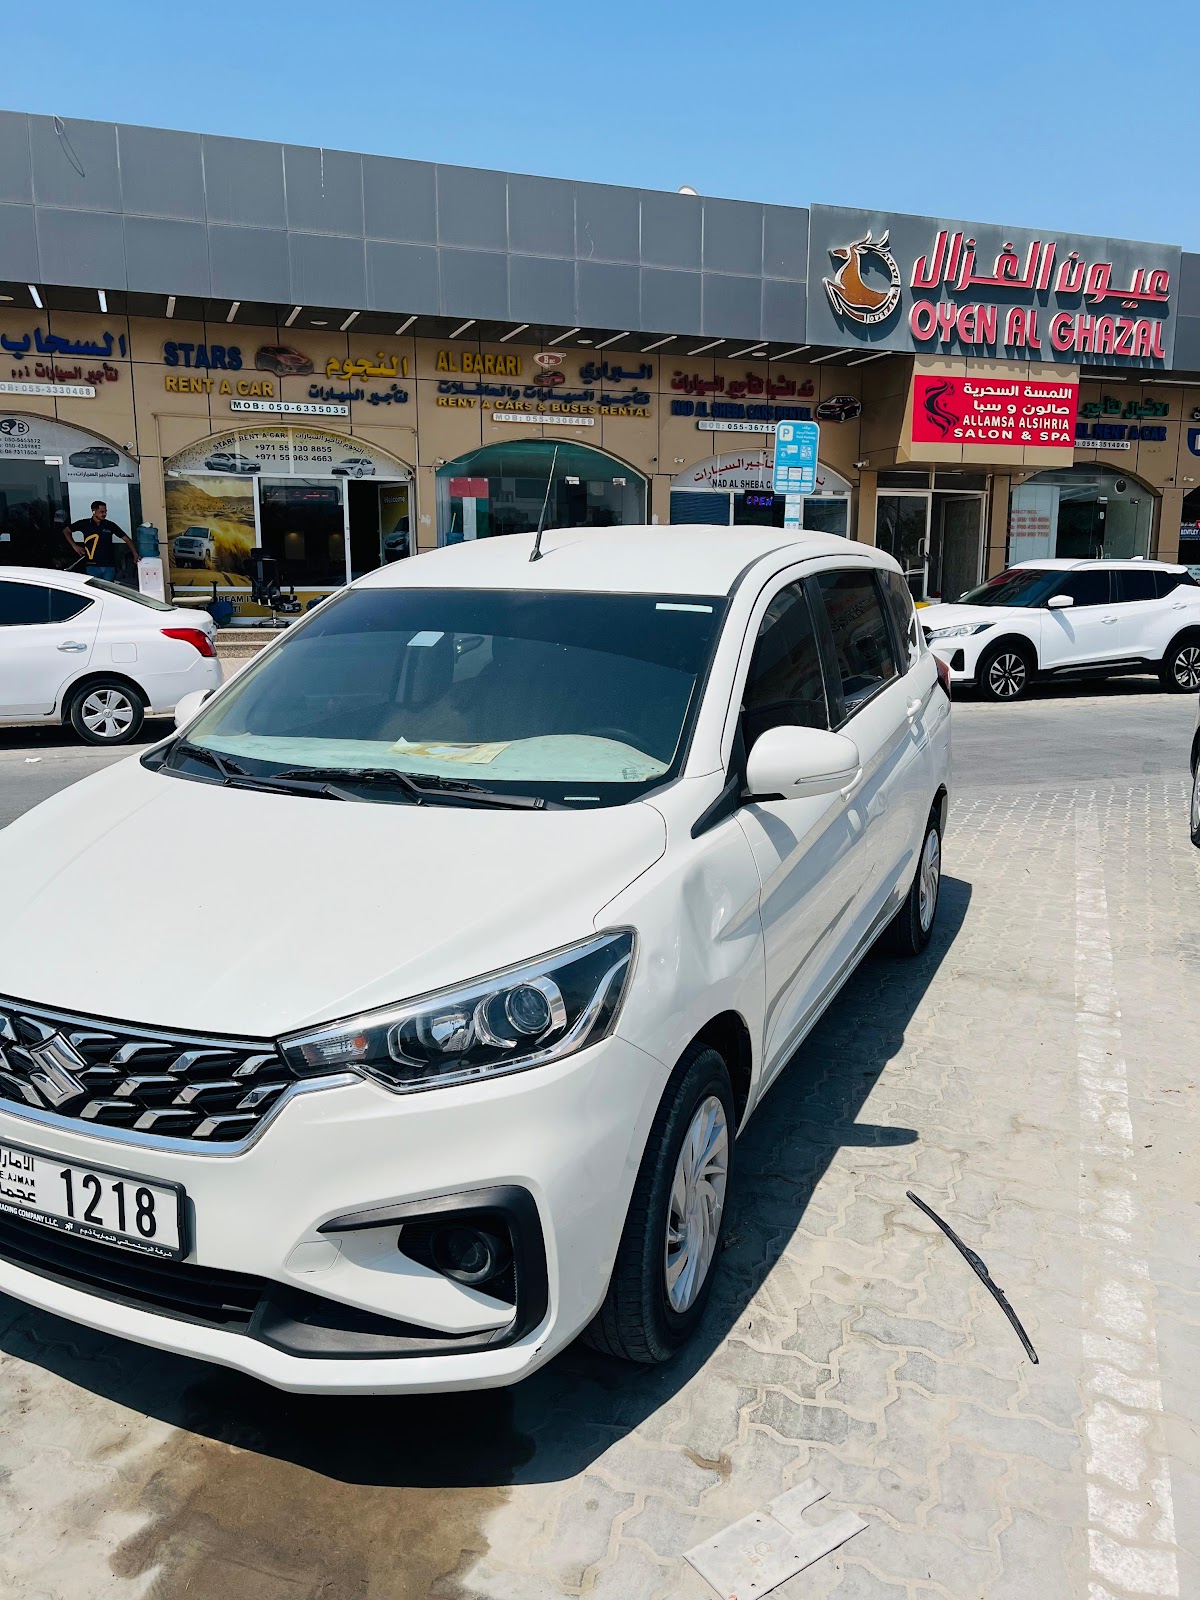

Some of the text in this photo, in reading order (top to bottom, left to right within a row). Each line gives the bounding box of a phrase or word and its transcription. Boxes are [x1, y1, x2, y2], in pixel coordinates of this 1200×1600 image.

[910, 230, 1170, 309] عيون الغزال
[908, 299, 1166, 359] OYEN AL GHAZAL
[1, 327, 127, 360] السحاب
[163, 341, 243, 371] STARS
[325, 351, 409, 382] النجوم
[436, 351, 522, 376] AL BARARI
[35, 362, 82, 382] السيارات
[0, 382, 91, 396] OB: 055-3330468
[165, 376, 274, 398] RENT A CAR
[671, 370, 725, 396] السيارات
[963, 382, 1072, 400] اللمسة السحرية
[308, 383, 409, 406] لتأجير السيارات
[233, 401, 346, 414] MOB: 050-6335035
[437, 396, 651, 417] RENT A CARS & BUSES RENTAL
[495, 413, 522, 421] MOB:
[671, 400, 812, 421] NAD AL SHEBA CARS RENTAL
[973, 400, 1070, 416] صالون و سبا
[700, 421, 776, 432] MOB: 055-36715
[963, 414, 1069, 430] ALLAMSA ALSIHRIA
[1076, 422, 1166, 441] AL RENT A CAR
[213, 437, 237, 450] STARS
[239, 433, 259, 442] RENT
[953, 428, 1071, 442] SALON & SPA
[694, 458, 744, 482] السيارات
[712, 479, 727, 488] NAD
[729, 479, 739, 488] AL
[740, 480, 765, 489] SHEBA
[747, 496, 773, 506] OPEN
[0, 1149, 35, 1172] الامارا
[0, 1181, 37, 1204] عجما
[60, 1168, 157, 1238] 1218
[0, 1202, 18, 1214] ADING
[18, 1208, 45, 1223] COMPANY
[154, 1247, 173, 1258] شركة
